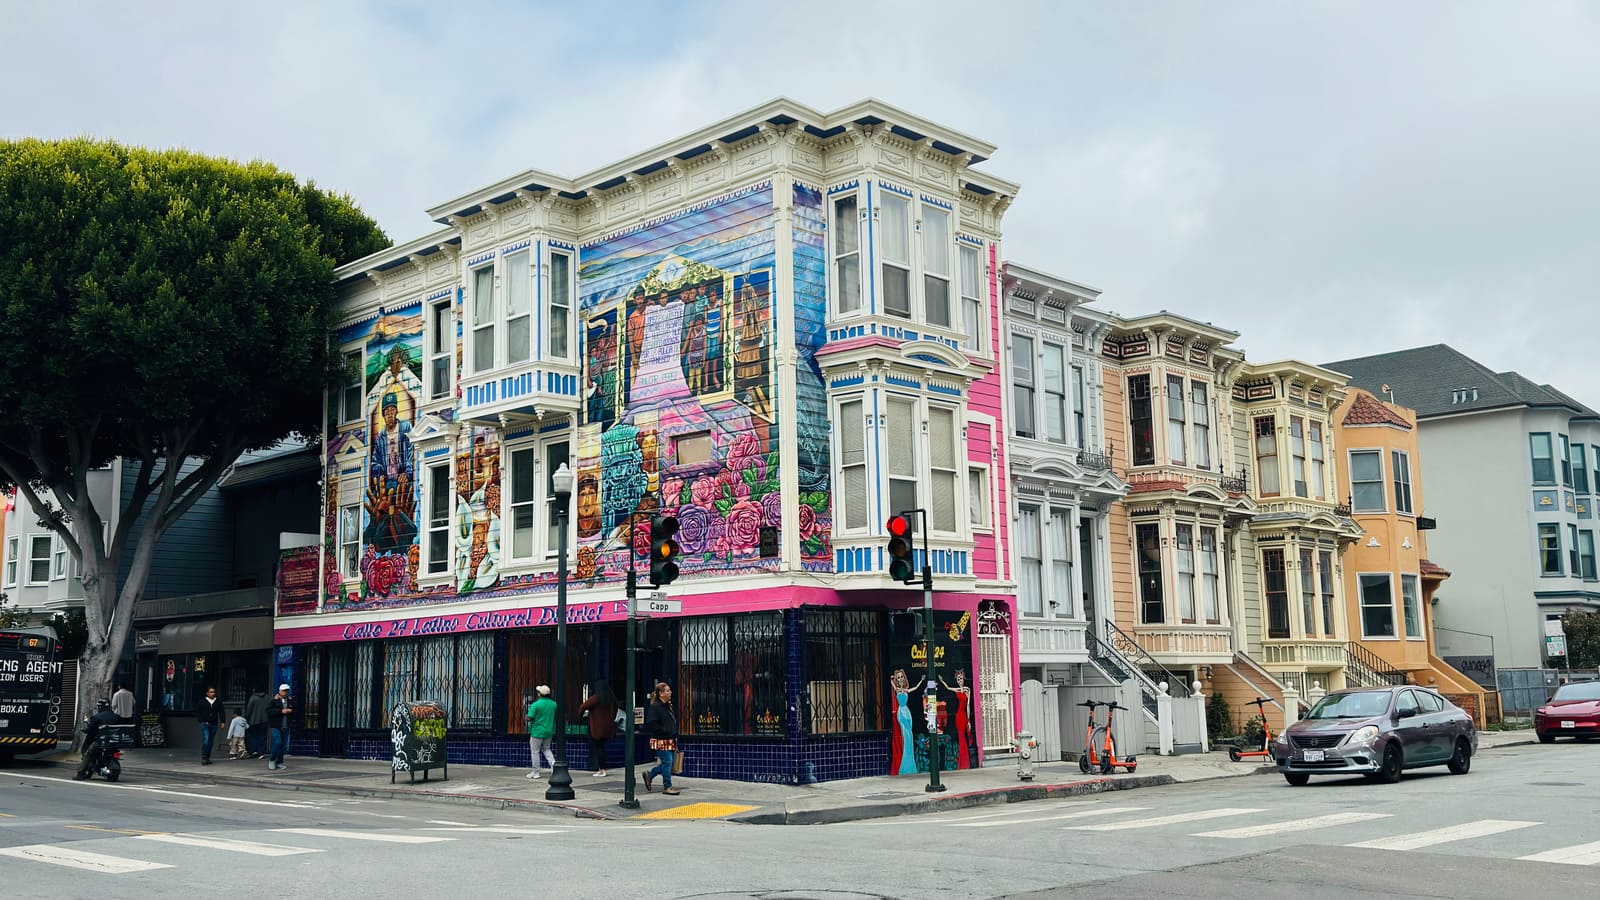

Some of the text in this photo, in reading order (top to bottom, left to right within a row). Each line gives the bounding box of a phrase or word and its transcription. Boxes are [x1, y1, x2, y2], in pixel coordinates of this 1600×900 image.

[650, 602, 669, 612] Capp
[343, 624, 382, 639] Calle
[388, 620, 408, 636] 24
[411, 617, 460, 635] Latino
[466, 609, 531, 630] Cultural
[538, 604, 603, 624] Ditrict
[29, 638, 38, 647] 67
[933, 646, 945, 658] 24
[26, 661, 63, 673] AGENT
[20, 674, 44, 682] USERS
